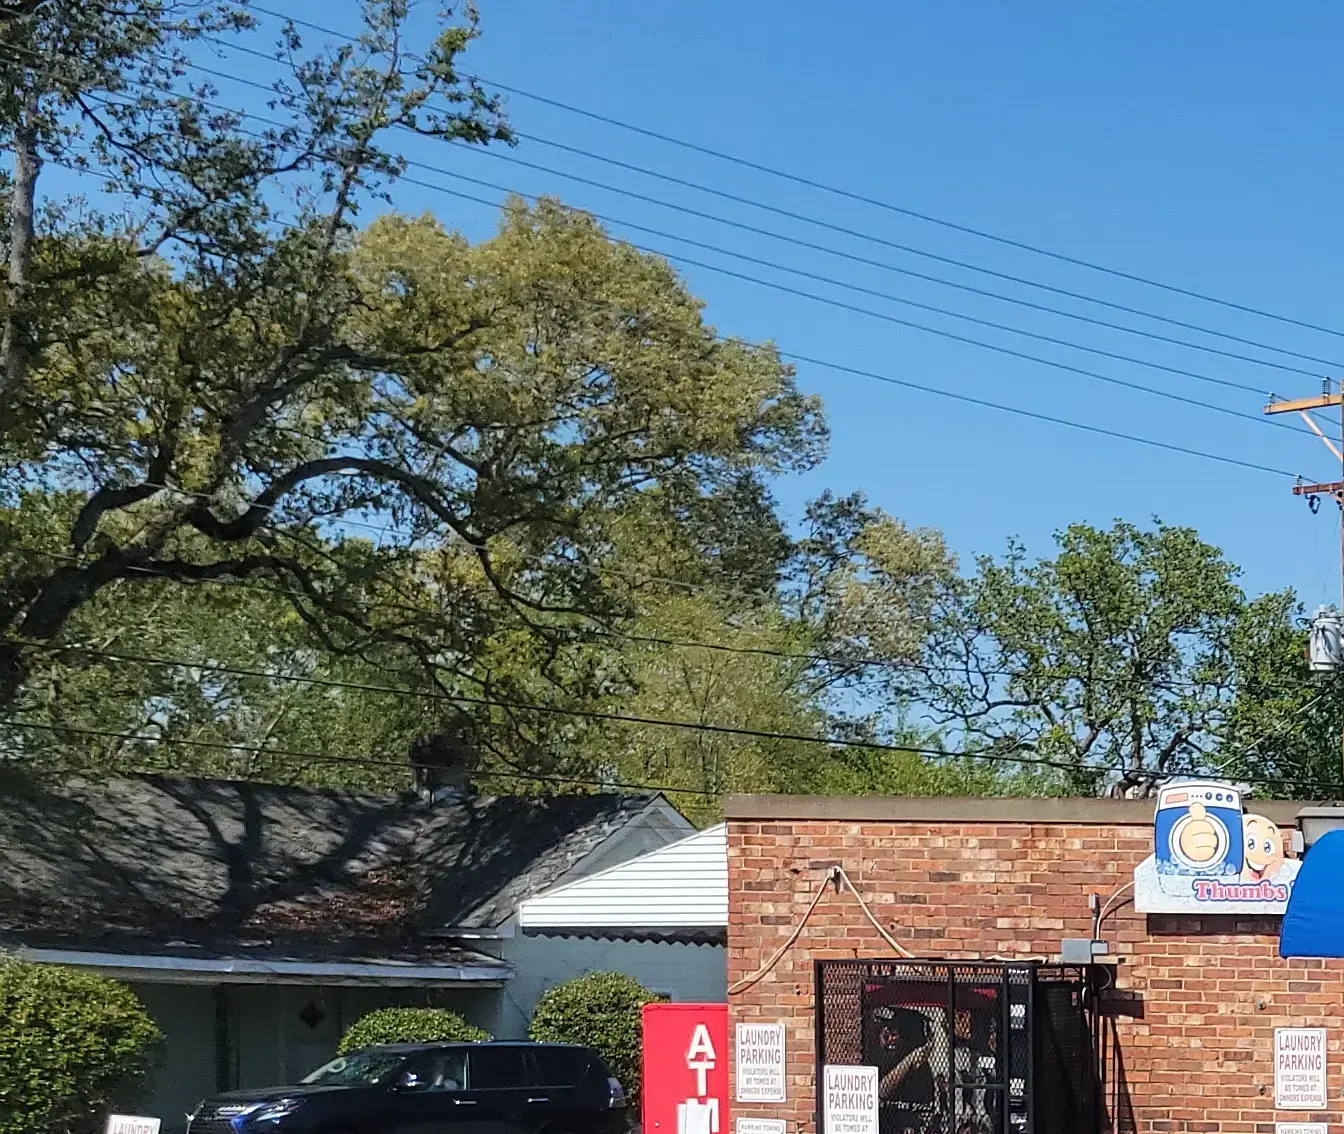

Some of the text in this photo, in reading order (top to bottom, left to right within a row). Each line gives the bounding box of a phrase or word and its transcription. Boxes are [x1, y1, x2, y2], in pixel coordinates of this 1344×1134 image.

[1193, 879, 1288, 902] Thumbs
[740, 1030, 780, 1045] LAUNDRY
[1280, 1035, 1322, 1051] LAUNDRY
[740, 1049, 781, 1064] PARKING
[1280, 1054, 1322, 1070] PARKING
[828, 1074, 873, 1091] LAUNDRY
[829, 1093, 873, 1110] PARKING
[860, 1114, 872, 1122] WILL
[835, 1124, 842, 1132] BE
[843, 1124, 860, 1132] TOWED
